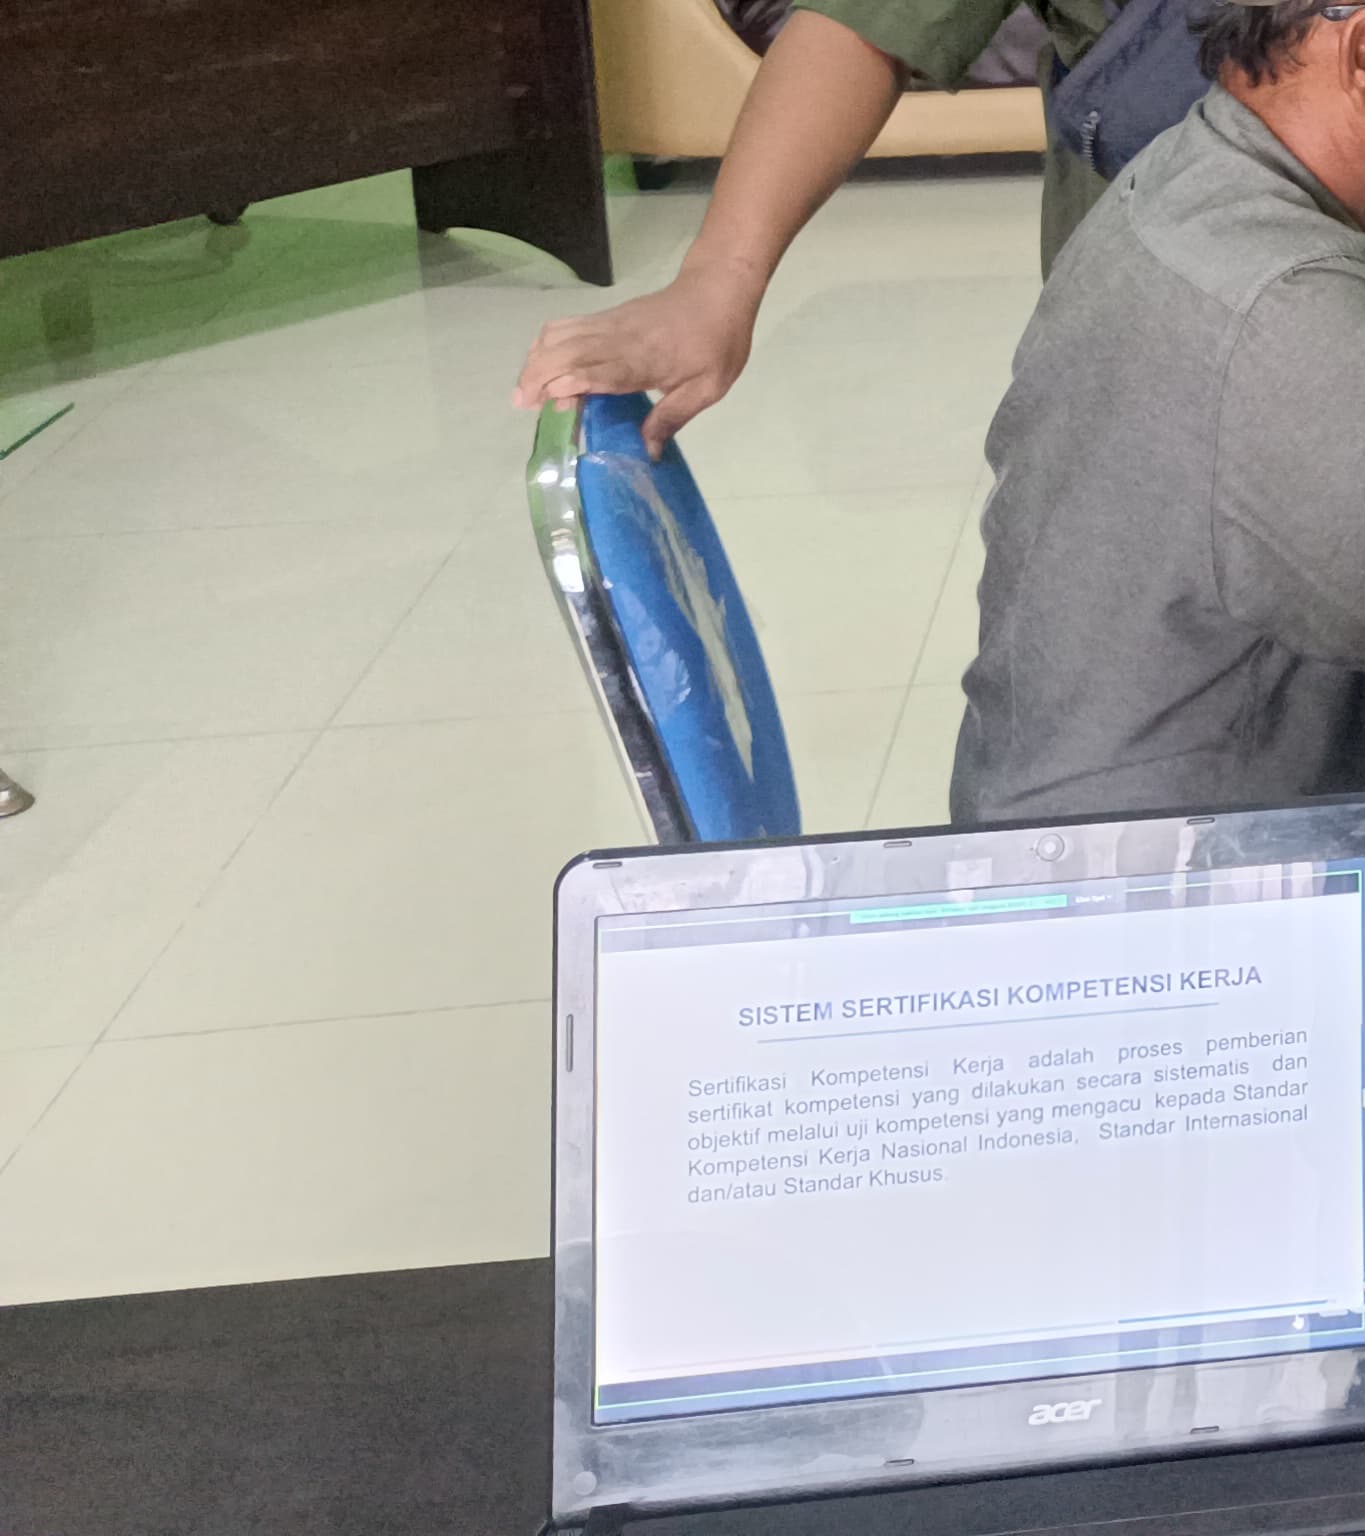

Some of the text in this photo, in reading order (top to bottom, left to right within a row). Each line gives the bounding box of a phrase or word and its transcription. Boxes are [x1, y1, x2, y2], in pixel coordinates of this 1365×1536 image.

[738, 966, 1263, 1027] SISTEM SERTIFIKASI KOMPETENSI KERJA
[687, 1056, 1308, 1124] sertifikat kompetensi yang dilakukan secara sistematis dan
[688, 1030, 1308, 1097] Sertifikasi Kompetensi Kerja adalah proses pemberian
[687, 1080, 1309, 1153] objektif melalui uji kompetensi yang mengacu kepada Standar
[688, 1150, 808, 1176] Kompetensi
[819, 1145, 871, 1166] Kerja
[881, 1136, 968, 1160] Nasional
[1099, 1118, 1175, 1140] Standar
[1185, 1104, 1308, 1132] Internasional
[688, 1181, 776, 1203] dan/atau
[784, 1173, 863, 1195] Standar
[1028, 1398, 1103, 1425] acer
